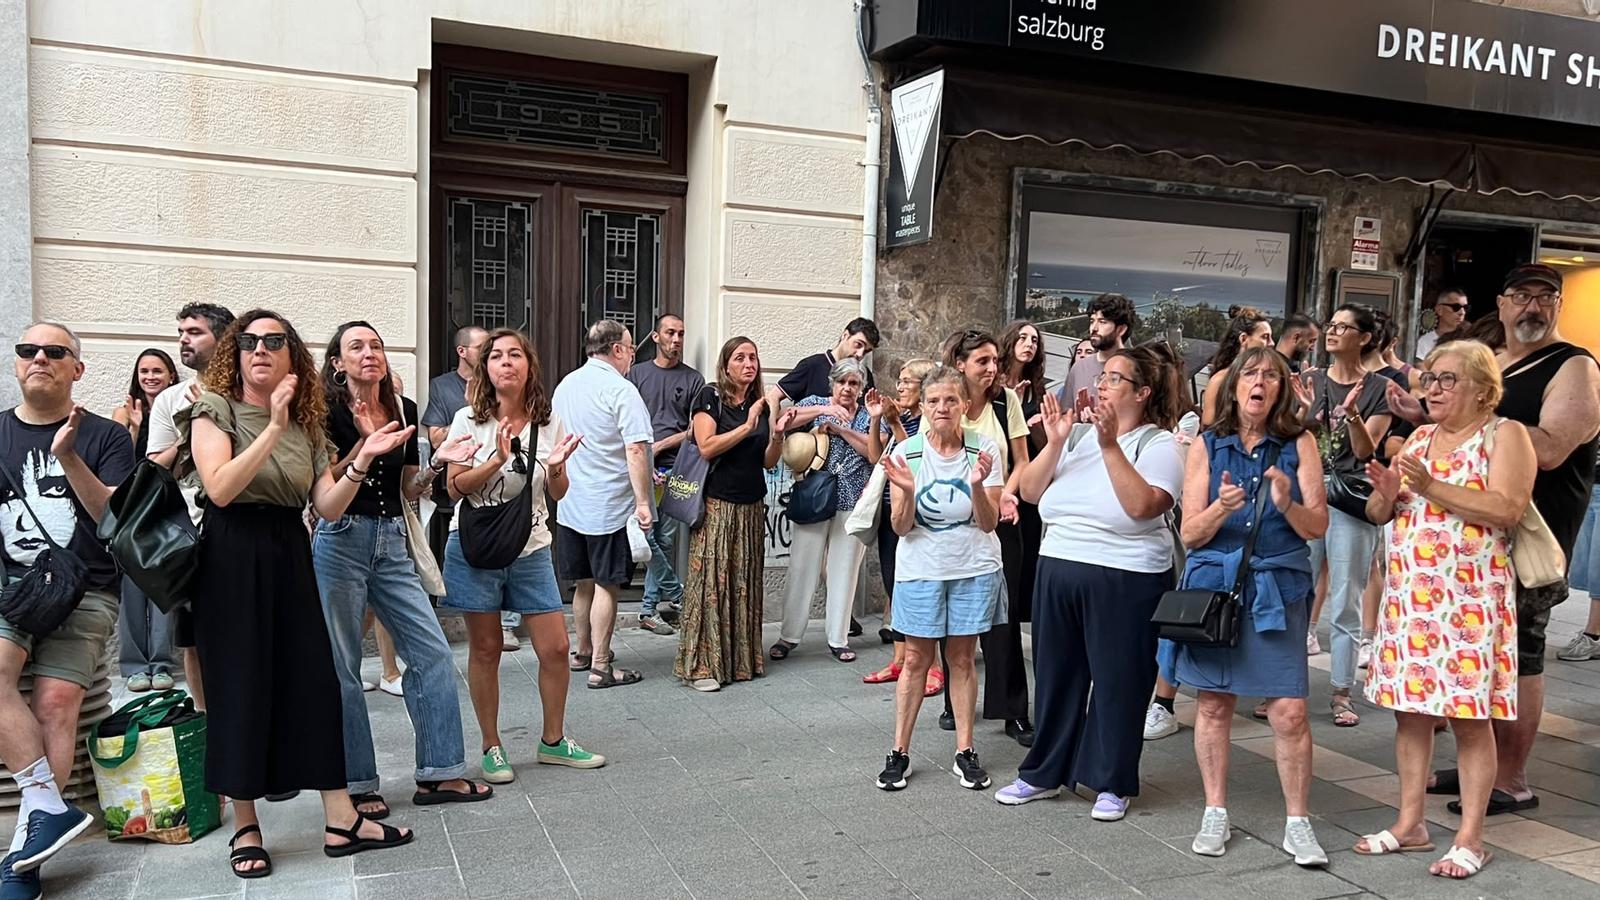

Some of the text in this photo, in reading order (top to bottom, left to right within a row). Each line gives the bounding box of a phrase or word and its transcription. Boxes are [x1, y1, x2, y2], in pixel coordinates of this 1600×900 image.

[1017, 12, 1105, 50] salzburg
[1377, 24, 1556, 80] DREIKANT
[494, 100, 621, 133] 1935
[897, 105, 933, 127] DREIKANT
[900, 213, 916, 226] TABLE
[1353, 240, 1379, 249] Alarma
